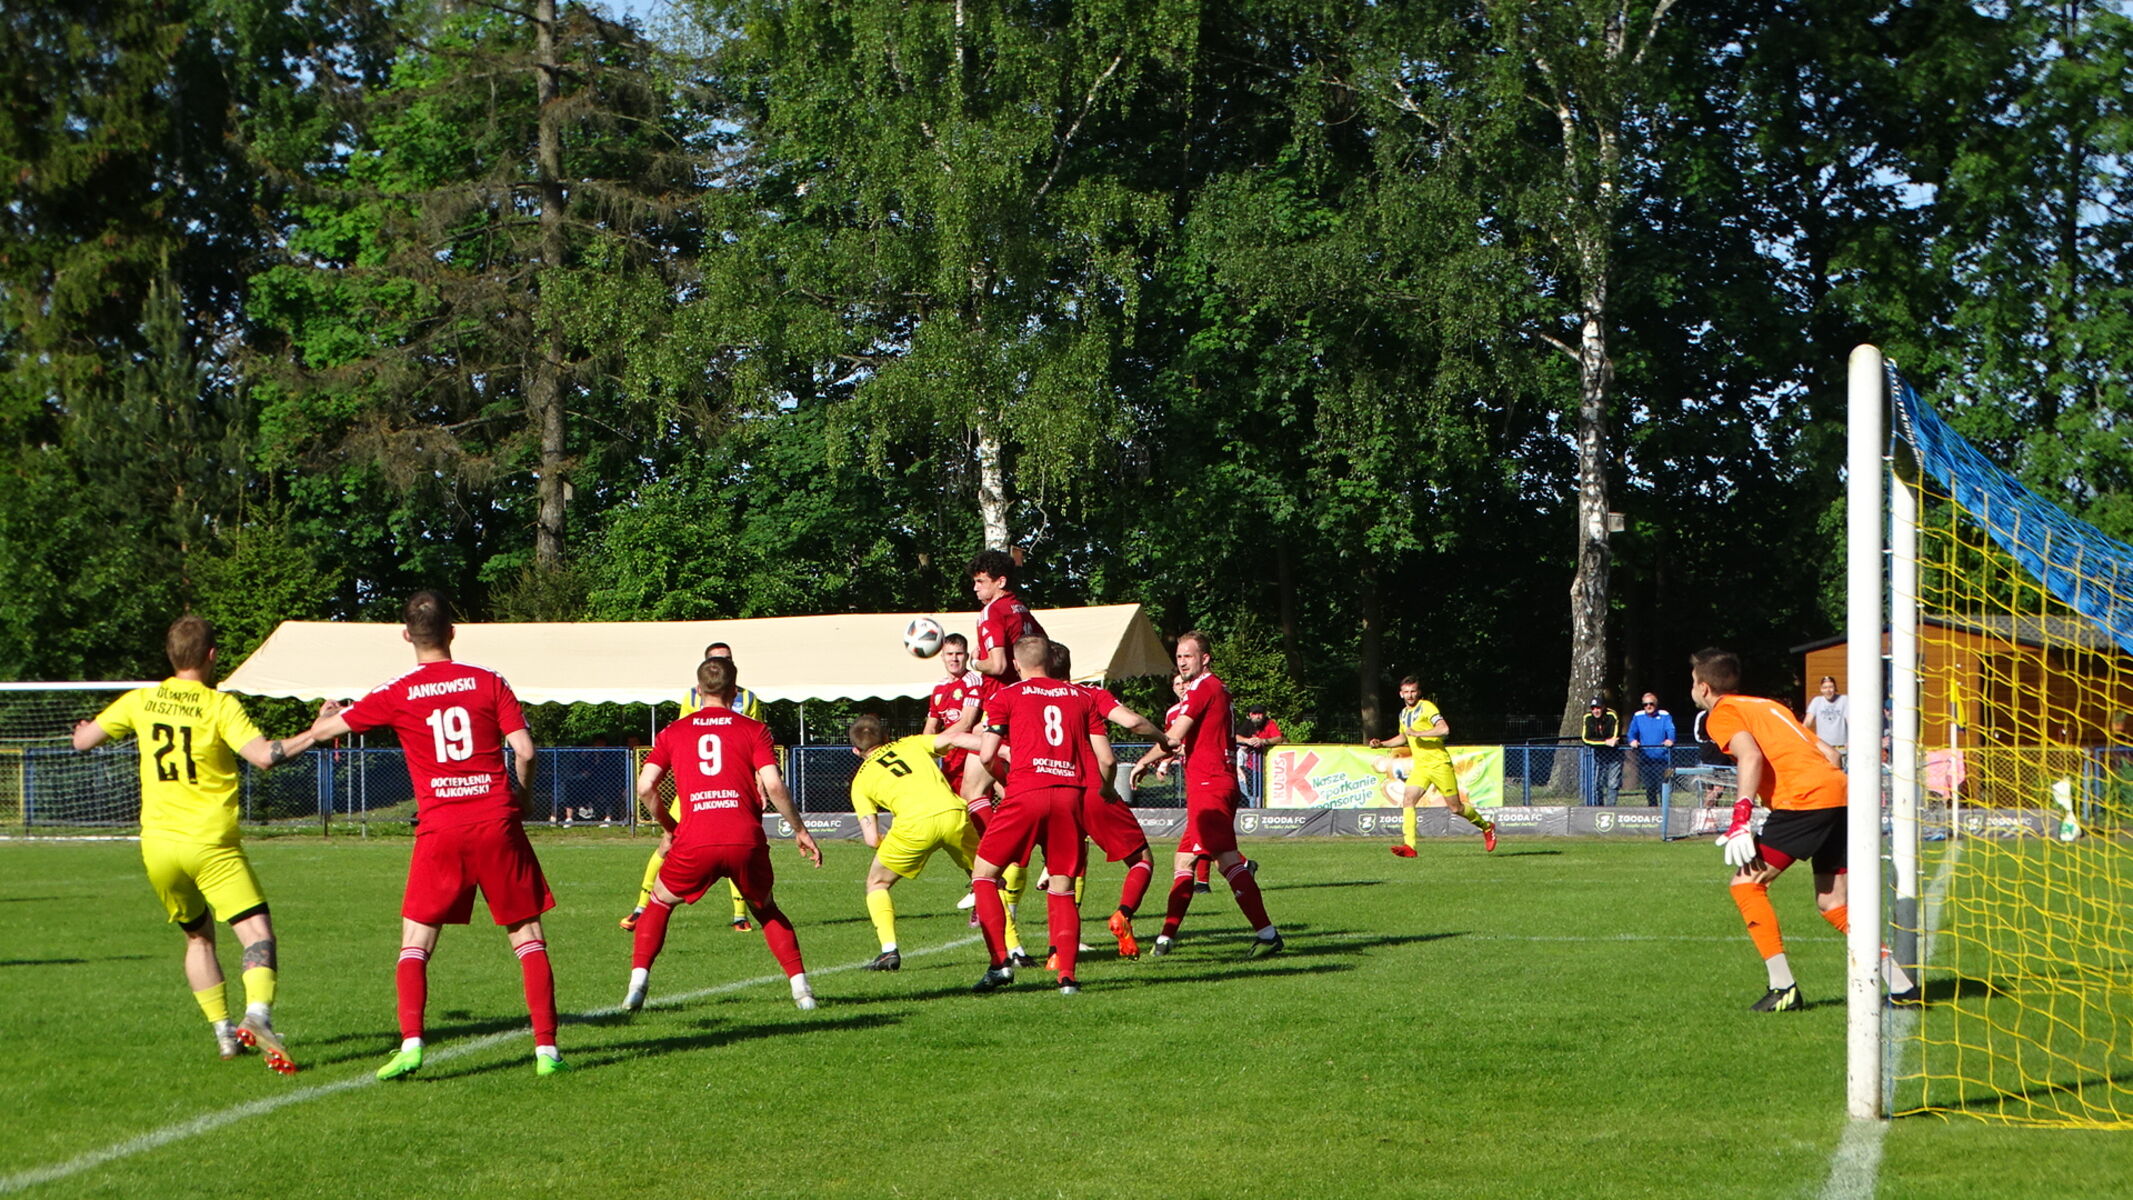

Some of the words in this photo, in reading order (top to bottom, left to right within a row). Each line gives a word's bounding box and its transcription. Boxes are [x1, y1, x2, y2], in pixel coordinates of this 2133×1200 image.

[407, 677, 477, 700] JANKOWSKI
[692, 717, 733, 726] KLIMEK
[1043, 705, 1064, 747] 8
[426, 706, 474, 763] 19
[152, 722, 198, 785] 21
[698, 733, 722, 776] 9
[876, 750, 913, 777] 5
[692, 800, 739, 812] JAJKOWSKI
[803, 820, 829, 828] GODA
[830, 820, 841, 828] FC
[1261, 816, 1294, 824] ZGODA
[1498, 814, 1530, 822] ZGODA
[1617, 815, 1650, 823] ZGODA
